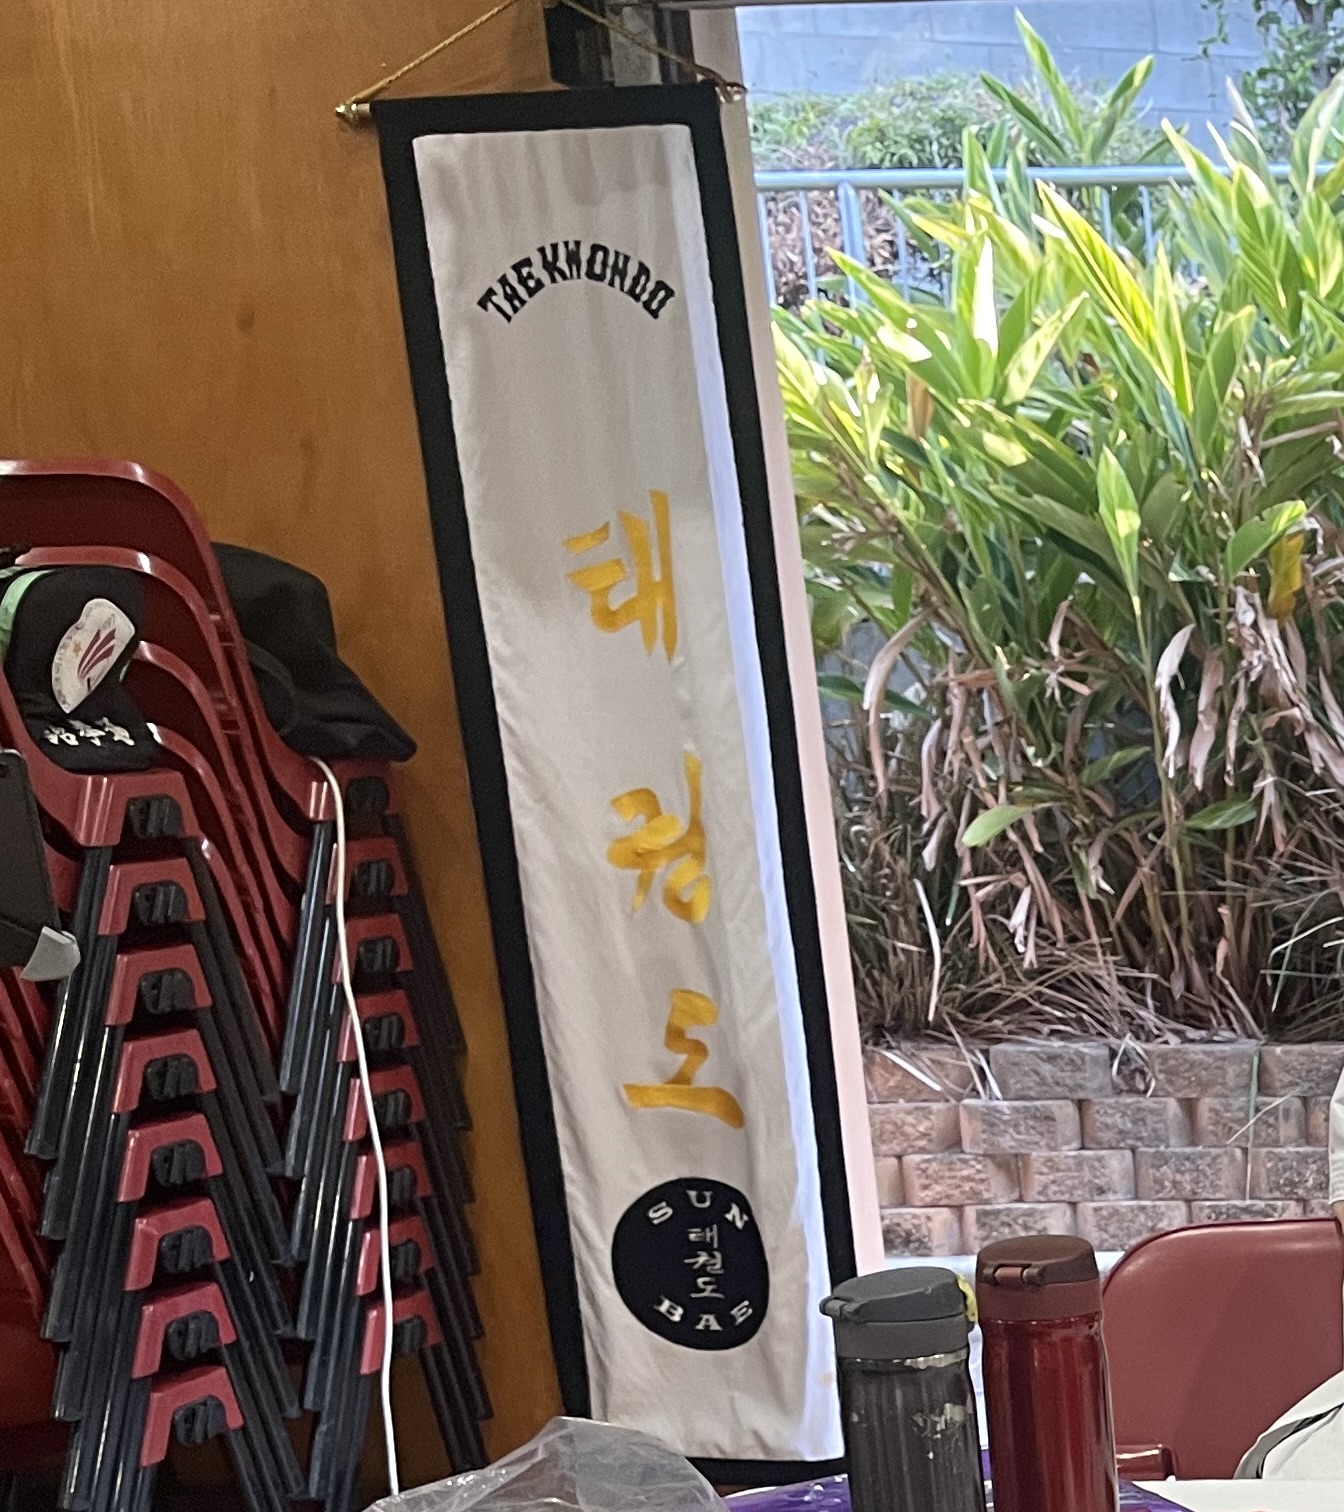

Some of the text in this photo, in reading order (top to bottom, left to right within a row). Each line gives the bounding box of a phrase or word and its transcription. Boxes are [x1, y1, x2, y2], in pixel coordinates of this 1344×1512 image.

[647, 1190, 749, 1230] SUN
[684, 1223, 725, 1299] 태권도
[653, 1296, 753, 1331] BAE
